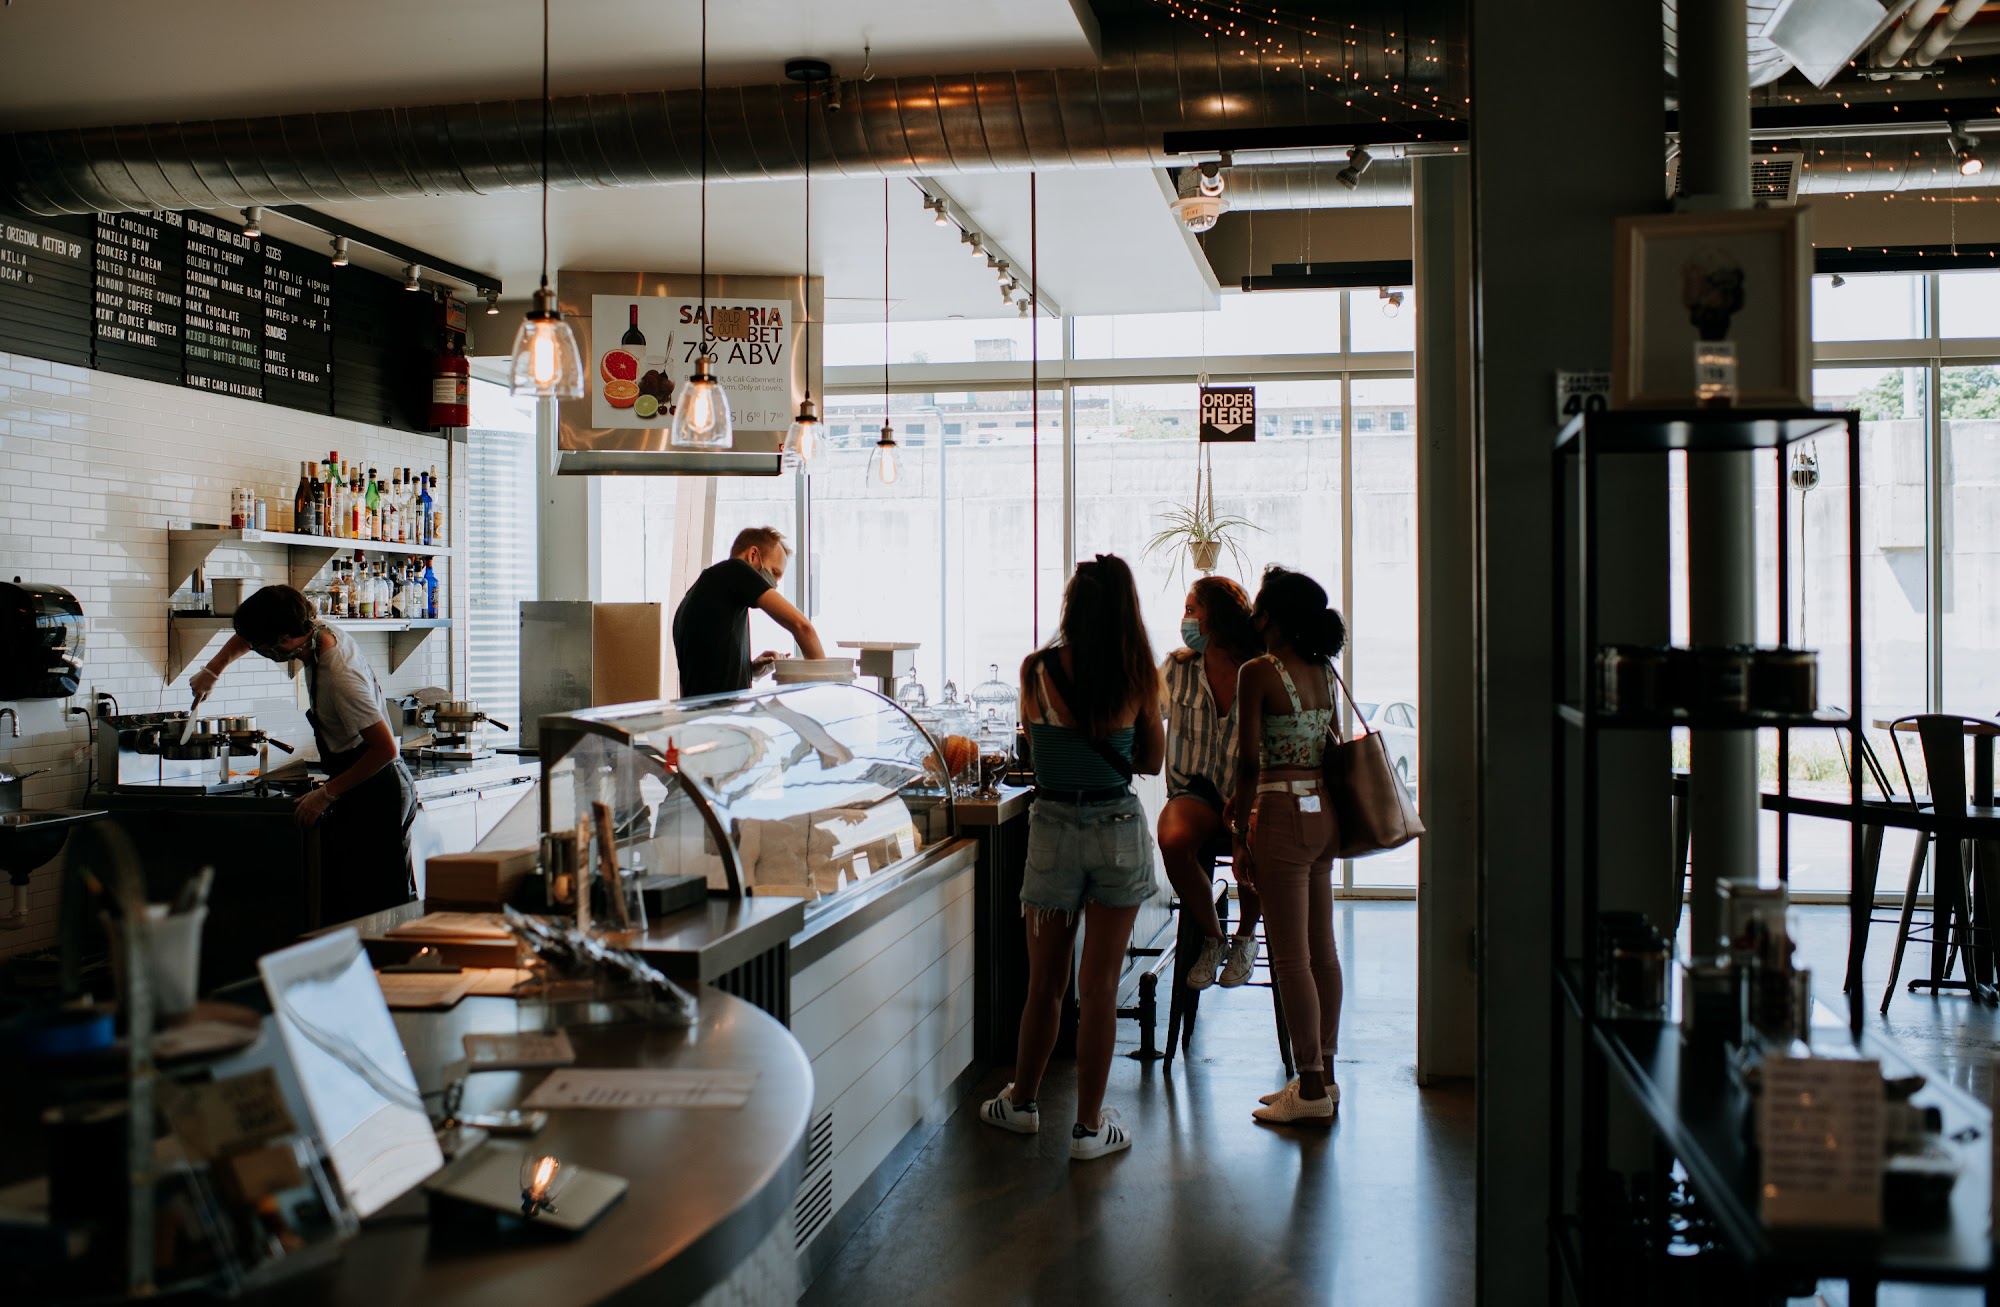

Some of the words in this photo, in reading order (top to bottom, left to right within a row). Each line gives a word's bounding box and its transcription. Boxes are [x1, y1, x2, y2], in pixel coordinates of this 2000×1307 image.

[98, 212, 115, 226] MILK
[121, 218, 158, 240] CHOCOLATE
[166, 210, 183, 228] CREAM
[6, 226, 39, 248] ORIGINAL
[42, 236, 67, 255] MITTEN
[69, 243, 81, 259] POP
[97, 227, 128, 246] VANILLA
[132, 238, 150, 252] BEAN
[188, 218, 215, 239] NON-DAIRY
[217, 228, 232, 244] VEGAN
[233, 234, 251, 250] GELATO
[96, 243, 128, 261] COOKIES
[141, 256, 162, 271] CREAM
[187, 240, 218, 258] AMARETTO
[222, 250, 244, 266] CHERRY
[266, 245, 282, 261] SIZES
[1, 266, 22, 282] DCAP
[96, 259, 123, 276] SALTED
[128, 268, 157, 286] CARAMEL
[187, 255, 210, 270] GOLDEN
[214, 262, 228, 276] MILK
[96, 275, 124, 292] ALMOND
[128, 284, 153, 300] TOFFEE
[157, 292, 181, 307] CRUNCH
[186, 284, 210, 300] MATCHA
[222, 280, 244, 295] ORANGE
[264, 279, 278, 291] PINT
[285, 285, 301, 298] QUART
[96, 292, 123, 307] MADCAP
[128, 300, 153, 316] COFFEE
[265, 292, 285, 307] FLIGHT
[96, 307, 114, 322] MINT
[118, 313, 144, 329] COOKIE
[148, 320, 177, 336] MONSTER
[186, 300, 203, 313] DARK
[206, 304, 240, 322] CHOCOLATE
[266, 308, 287, 321] WAFFLE
[680, 305, 783, 326] SARIA
[719, 311, 740, 323] SOLD
[98, 324, 125, 340] CASHEW
[128, 331, 157, 347] CARAMEL
[186, 314, 213, 331] BANANAS
[216, 322, 230, 335] GONE
[232, 326, 251, 339] NUTTY
[265, 324, 287, 341] SUNDAES
[706, 326, 783, 343] SBET
[186, 329, 206, 343] MIXED
[209, 335, 229, 348] BERRY
[232, 340, 257, 355] CRUMBLE
[186, 344, 210, 359] PEANUT
[213, 350, 236, 364] BUTTER
[240, 356, 260, 370] COOKIE
[266, 349, 286, 363] TURTLE
[683, 342, 718, 364] 7%
[728, 343, 782, 365] ABV
[264, 363, 288, 377] COOKIES
[298, 370, 314, 383] CREAM
[746, 376, 776, 384] Cabernet
[212, 380, 228, 392] CARB
[230, 383, 263, 398] AVAILABLE
[738, 384, 755, 392] Only
[1202, 394, 1253, 407] ORDER
[1563, 394, 1607, 415] 40
[1202, 407, 1253, 424] HERE
